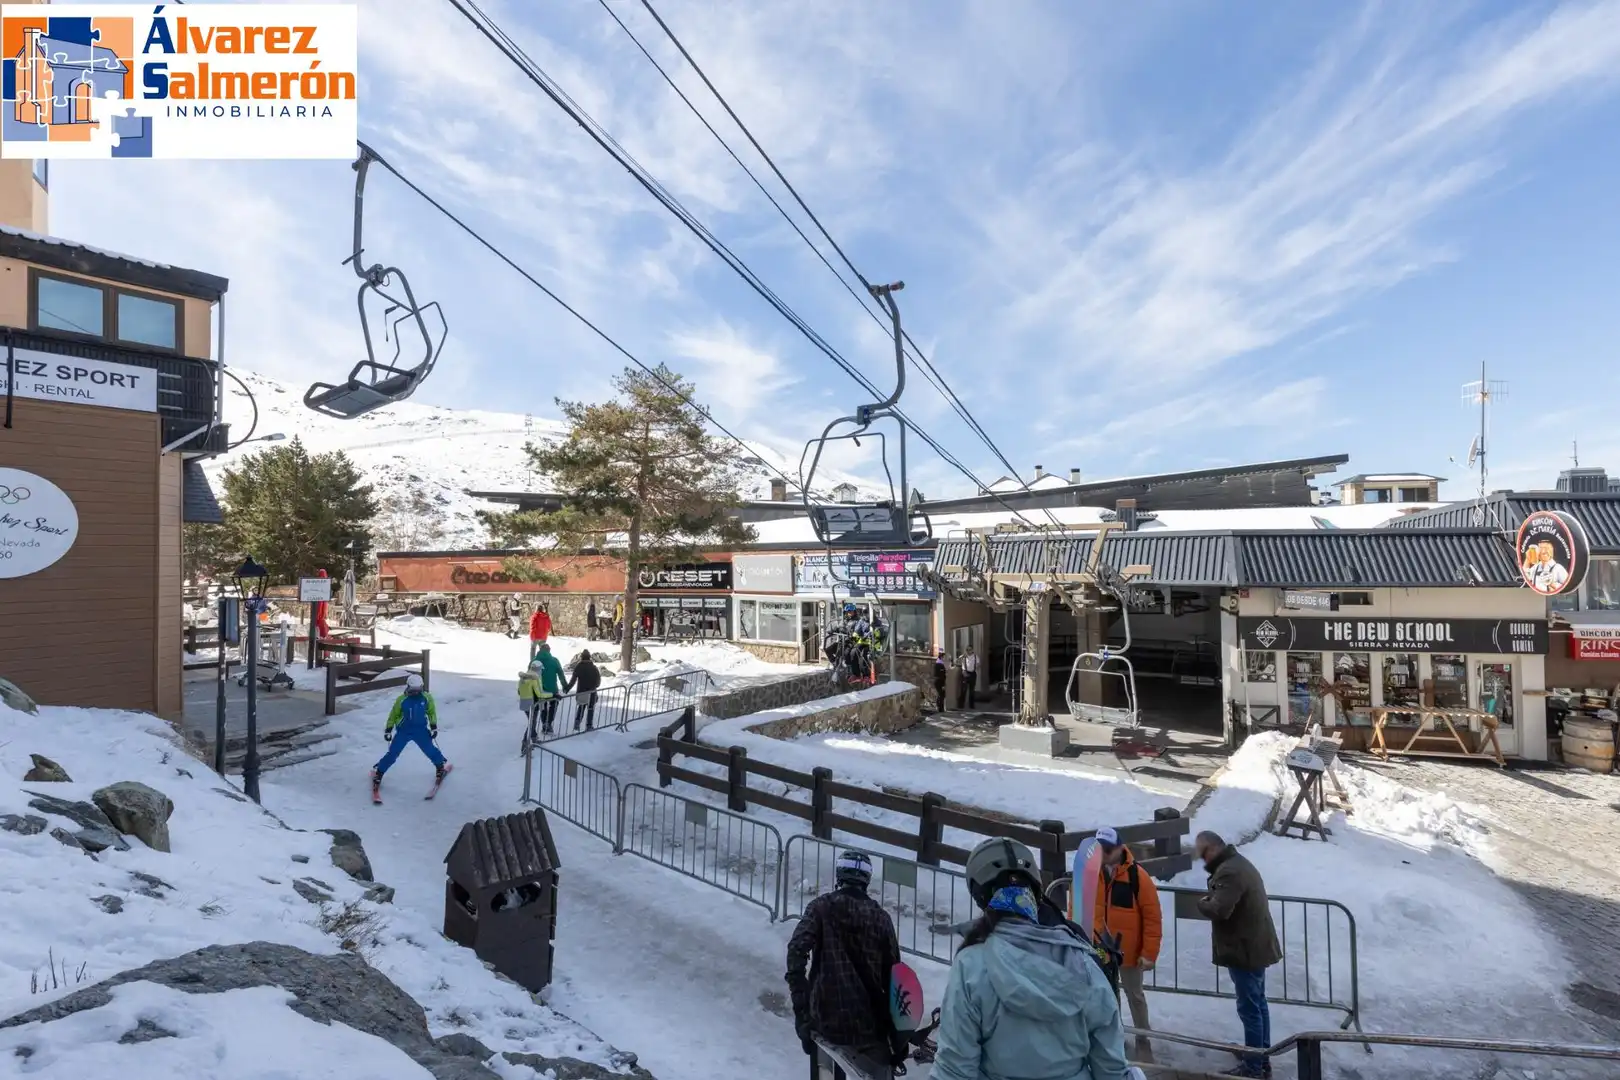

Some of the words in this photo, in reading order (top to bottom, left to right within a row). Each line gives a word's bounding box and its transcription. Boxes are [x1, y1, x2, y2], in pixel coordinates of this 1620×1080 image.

[56, 365, 140, 388] SPORT
[34, 383, 95, 399] RENTAL
[24, 517, 68, 535] Sport
[657, 570, 727, 582] RESET
[1296, 596, 1317, 606] DESDE
[1324, 621, 1352, 641] THE
[1357, 622, 1389, 641] NEW
[1396, 622, 1454, 642] SCHOOL
